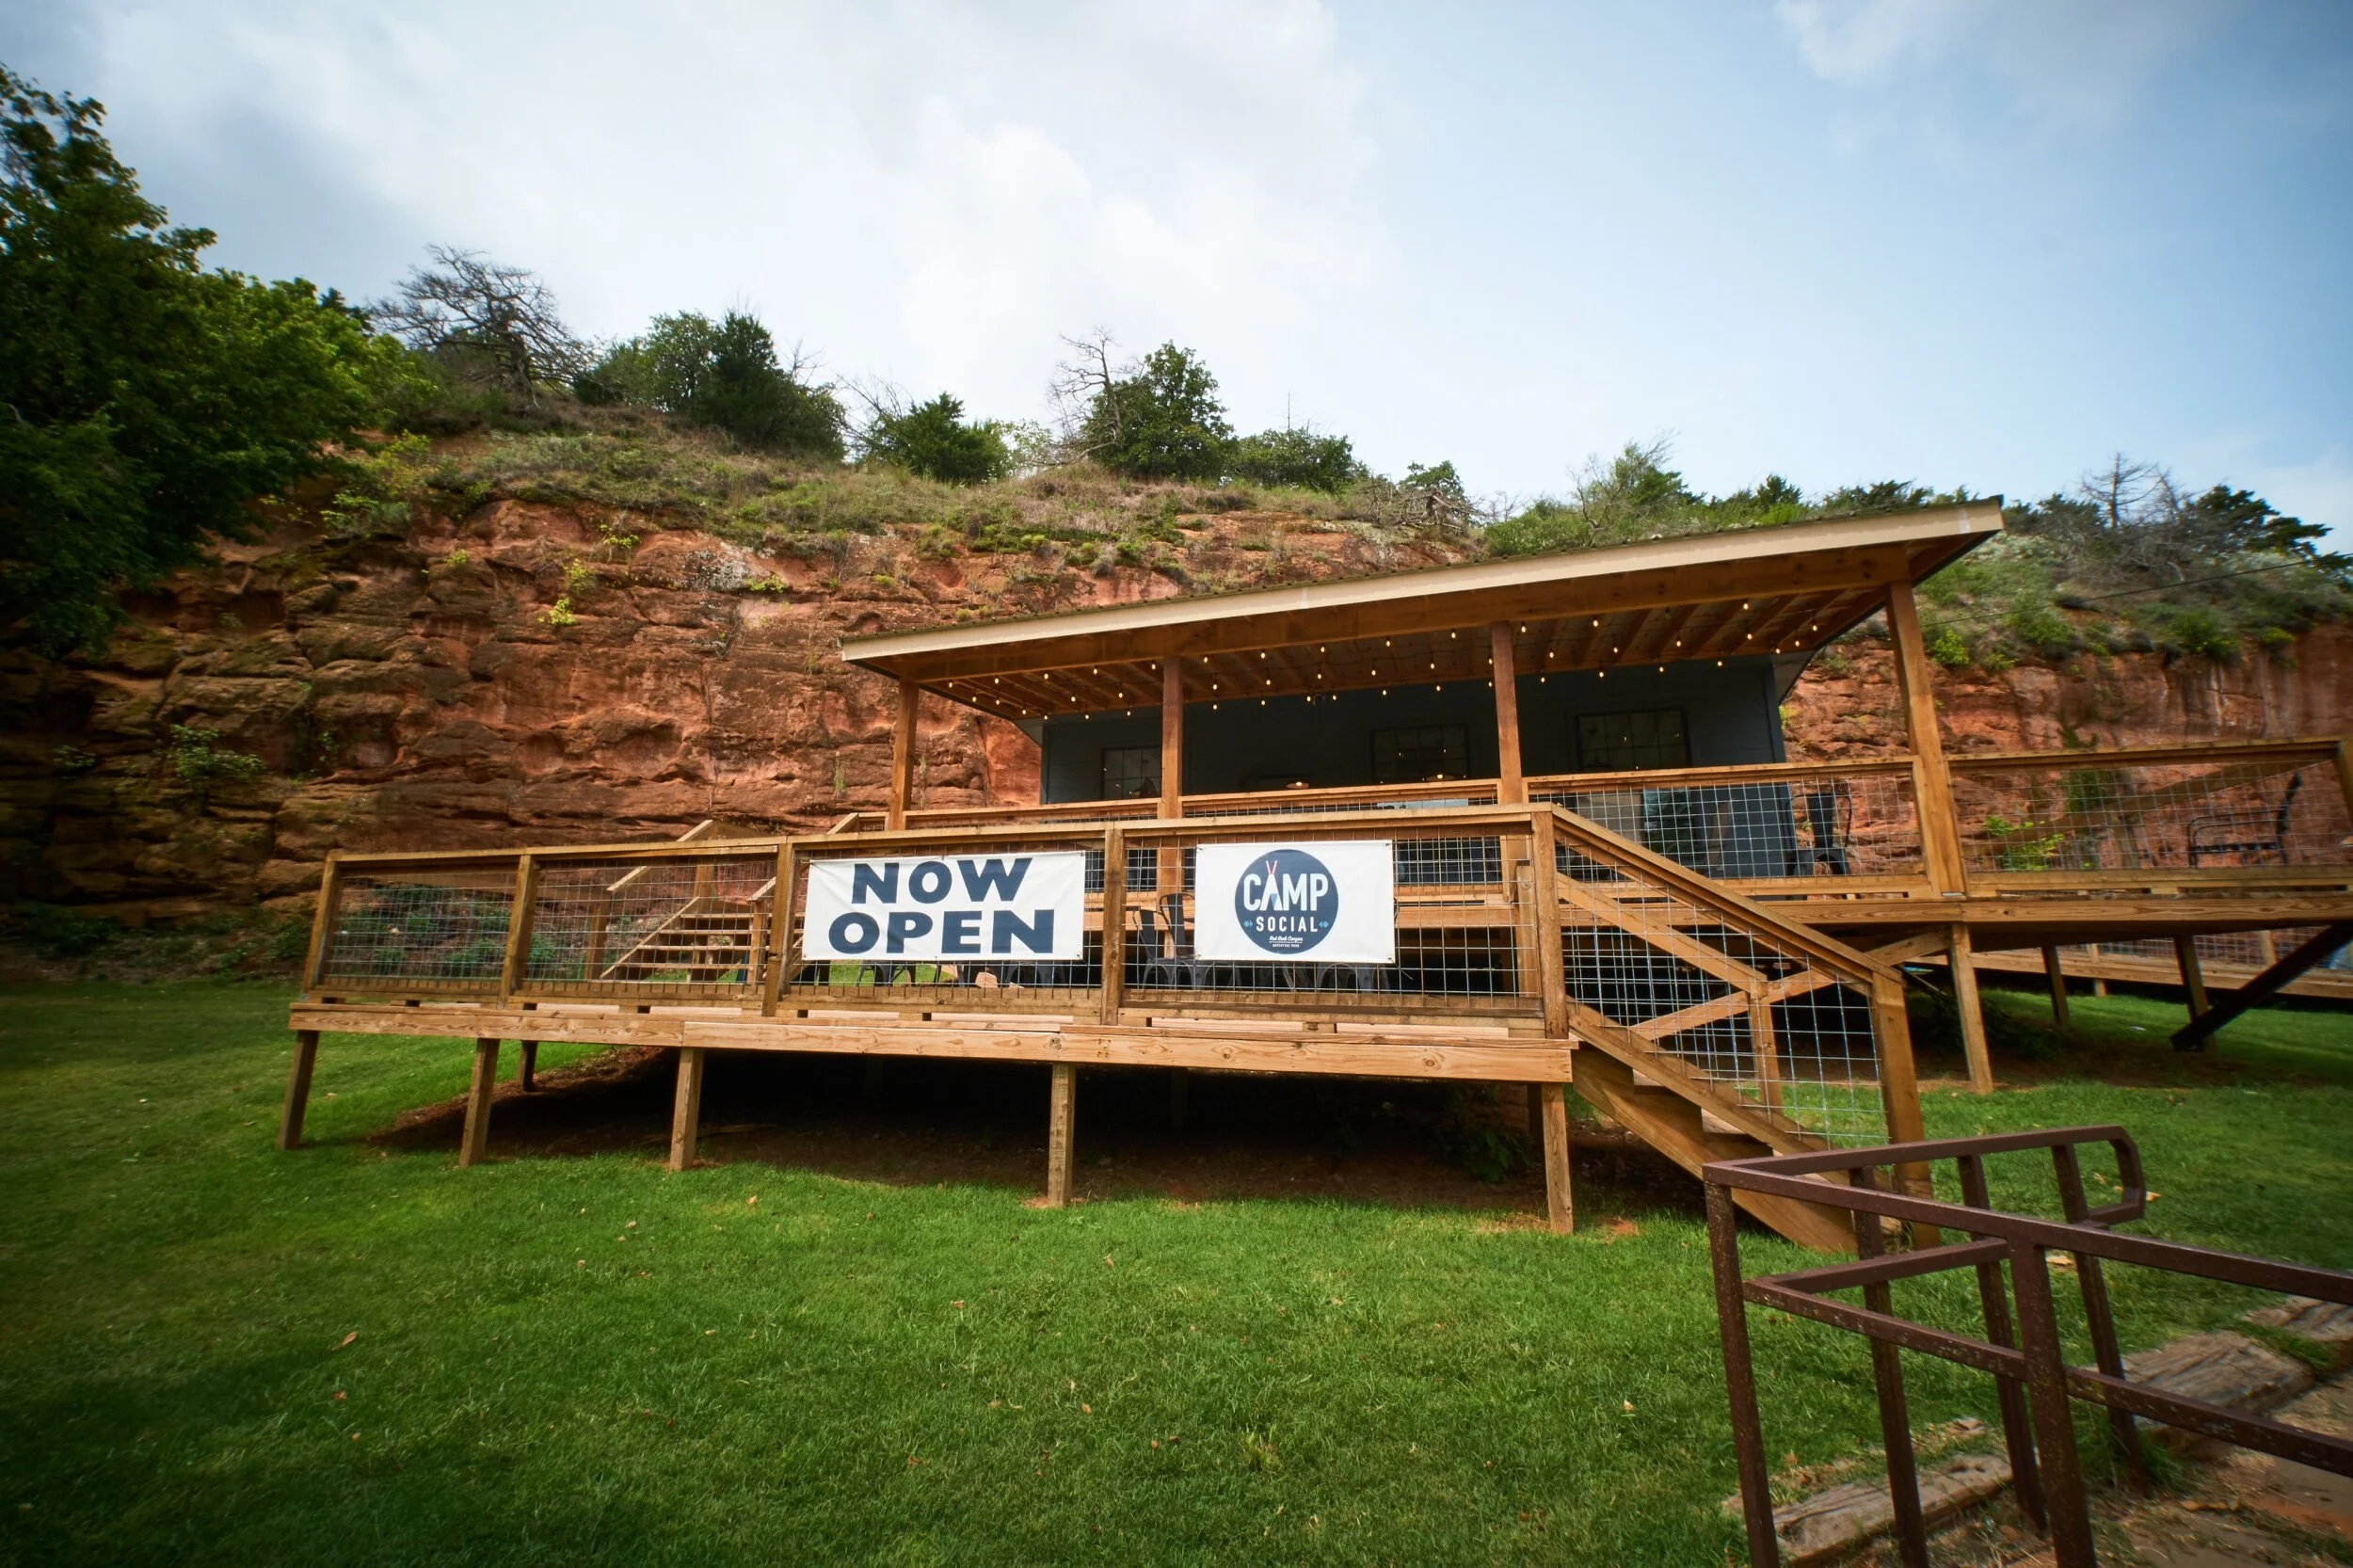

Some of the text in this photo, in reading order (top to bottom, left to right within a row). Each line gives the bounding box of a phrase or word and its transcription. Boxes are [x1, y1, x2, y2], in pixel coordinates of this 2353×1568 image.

[852, 857, 1032, 904] NOW
[1243, 872, 1329, 912] CAMP
[828, 909, 1055, 954] OPEN
[1256, 916, 1319, 933] SOCIAL
